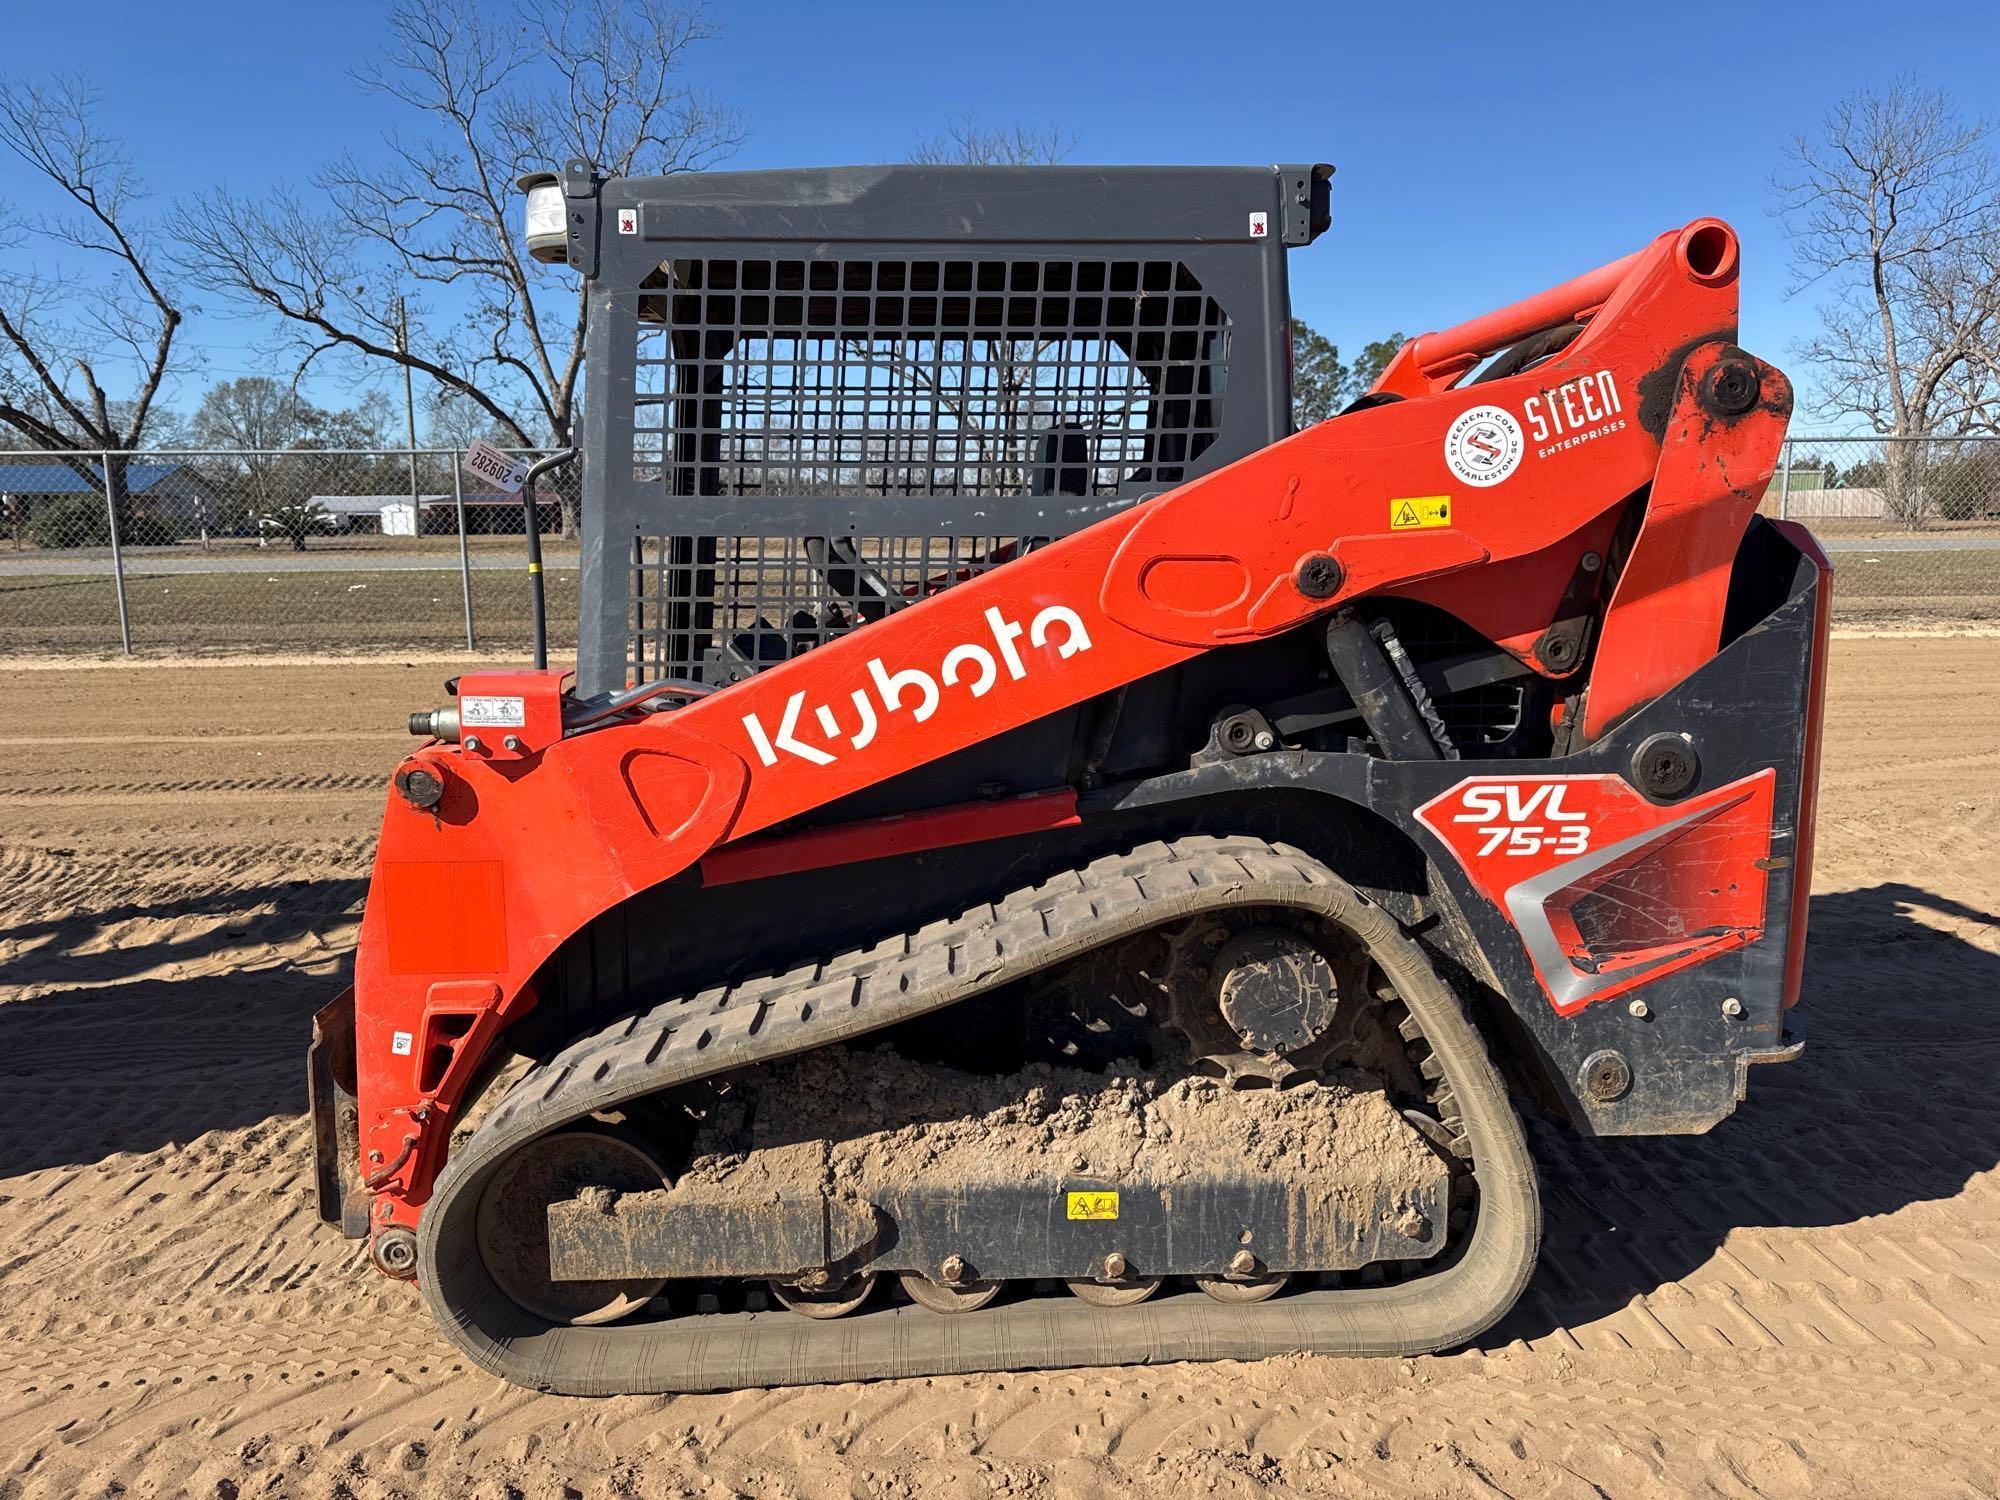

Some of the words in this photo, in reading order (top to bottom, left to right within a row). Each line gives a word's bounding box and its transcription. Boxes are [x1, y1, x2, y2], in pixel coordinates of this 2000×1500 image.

[1523, 369, 1622, 442] STEEN
[1450, 411, 1515, 456] STEENENT.COM
[1511, 440, 1518, 454] SC
[1538, 419, 1626, 459] ENTERPRISES
[471, 451, 513, 484] 209282
[741, 605, 1093, 767] Kubota
[1452, 784, 1587, 823] SVL
[1476, 826, 1592, 857] 75-3
